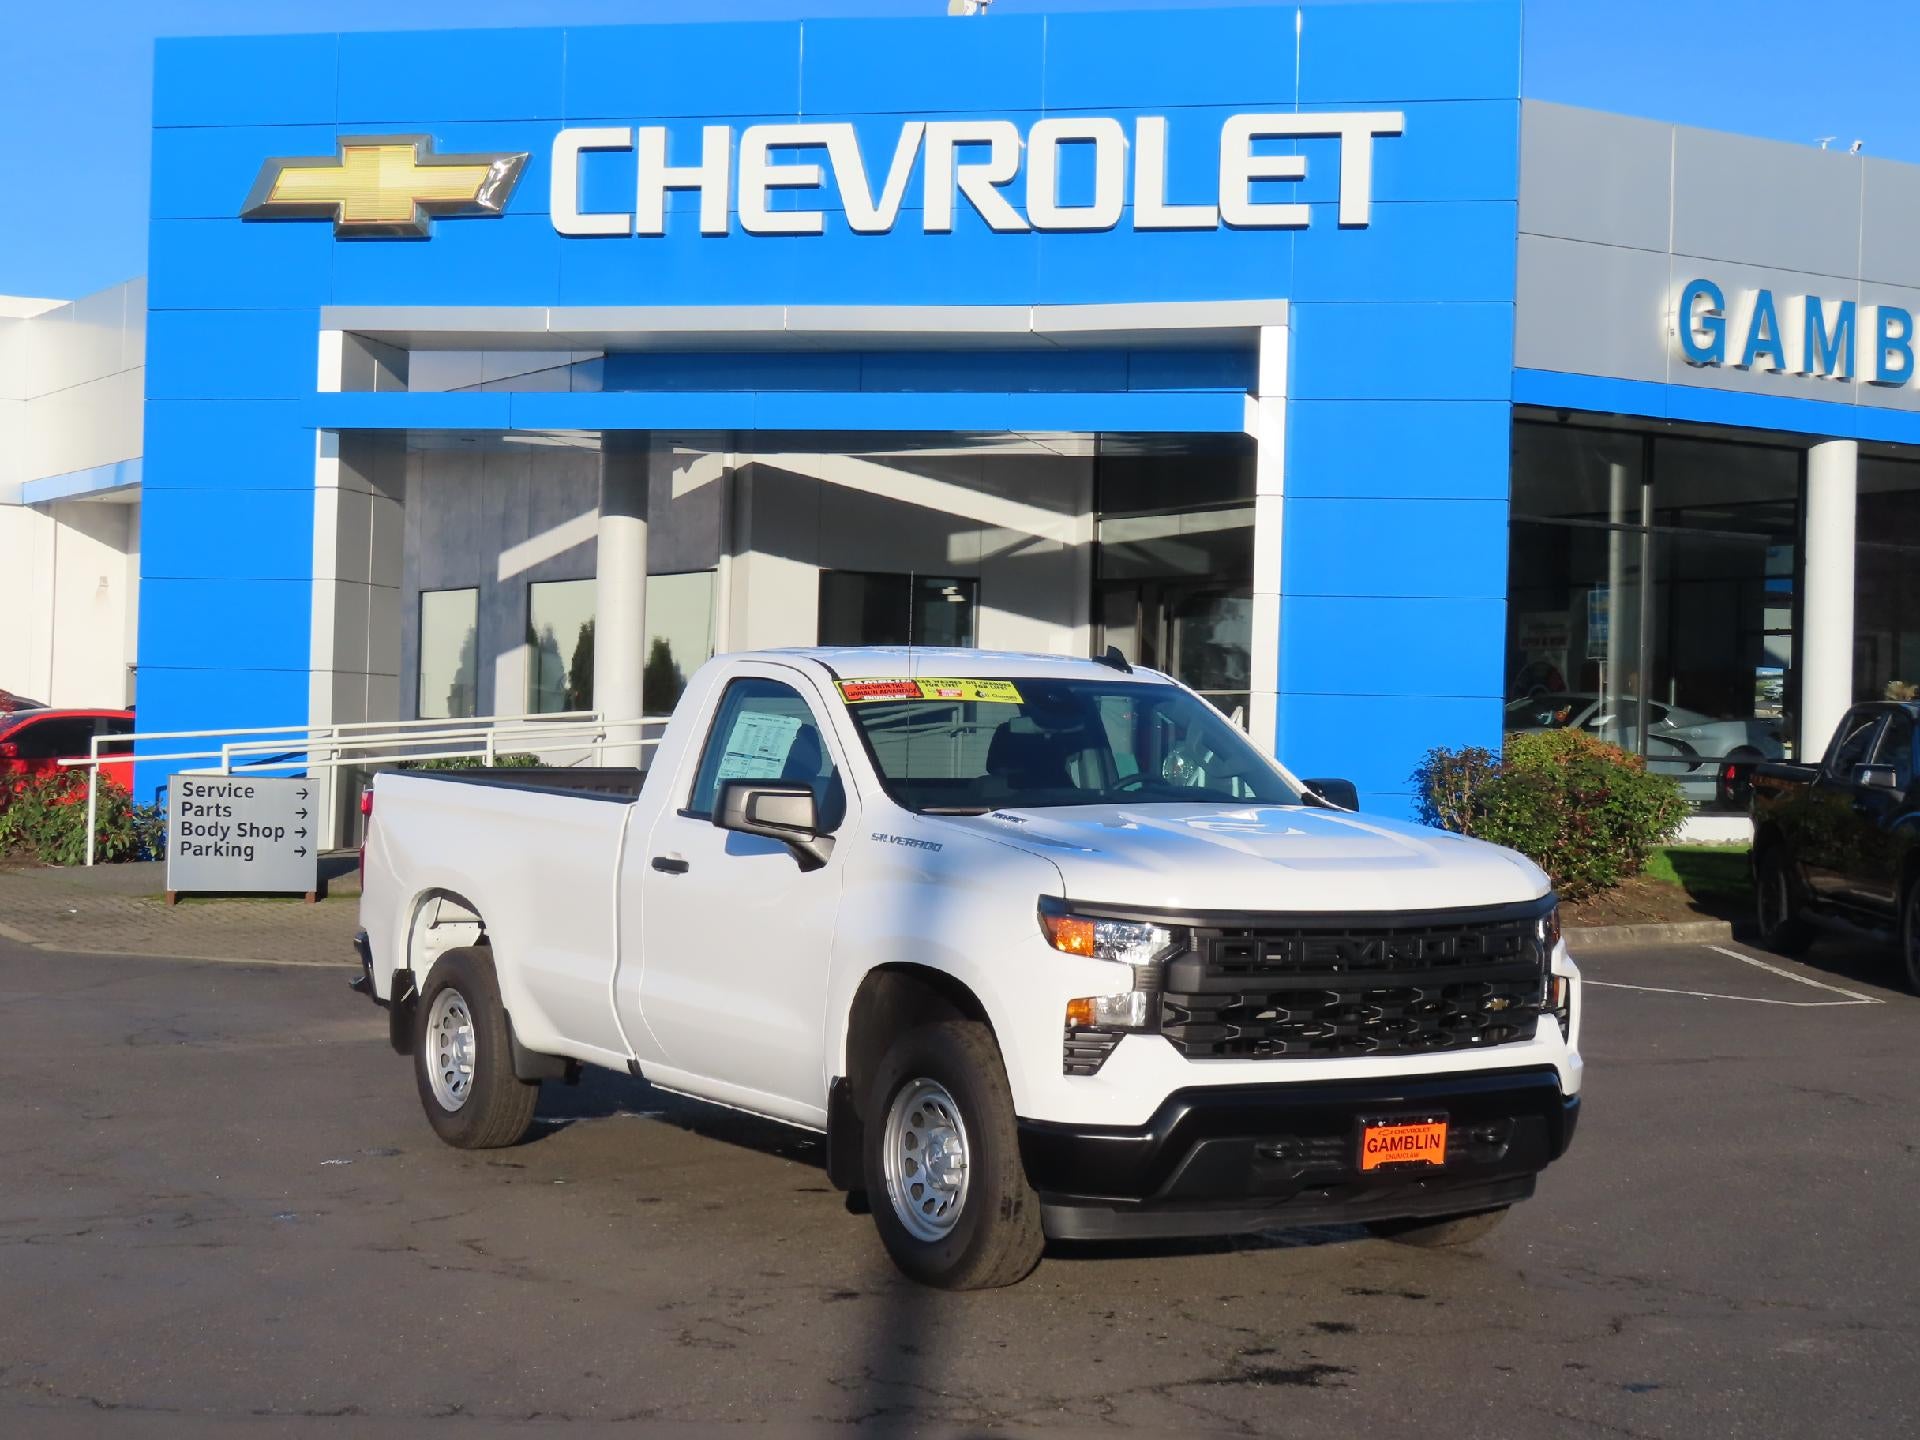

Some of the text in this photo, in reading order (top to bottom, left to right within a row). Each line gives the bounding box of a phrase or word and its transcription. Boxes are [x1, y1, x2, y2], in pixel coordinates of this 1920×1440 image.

[549, 110, 1404, 236] CHEVROLET
[1678, 278, 1920, 384] GAMB
[182, 782, 255, 798] Service
[181, 802, 232, 817] Parts
[181, 822, 285, 842] Body Shop
[180, 841, 254, 862] Parking
[871, 832, 944, 853] SILVERADO
[1366, 1133, 1441, 1153] GAMBLIN
